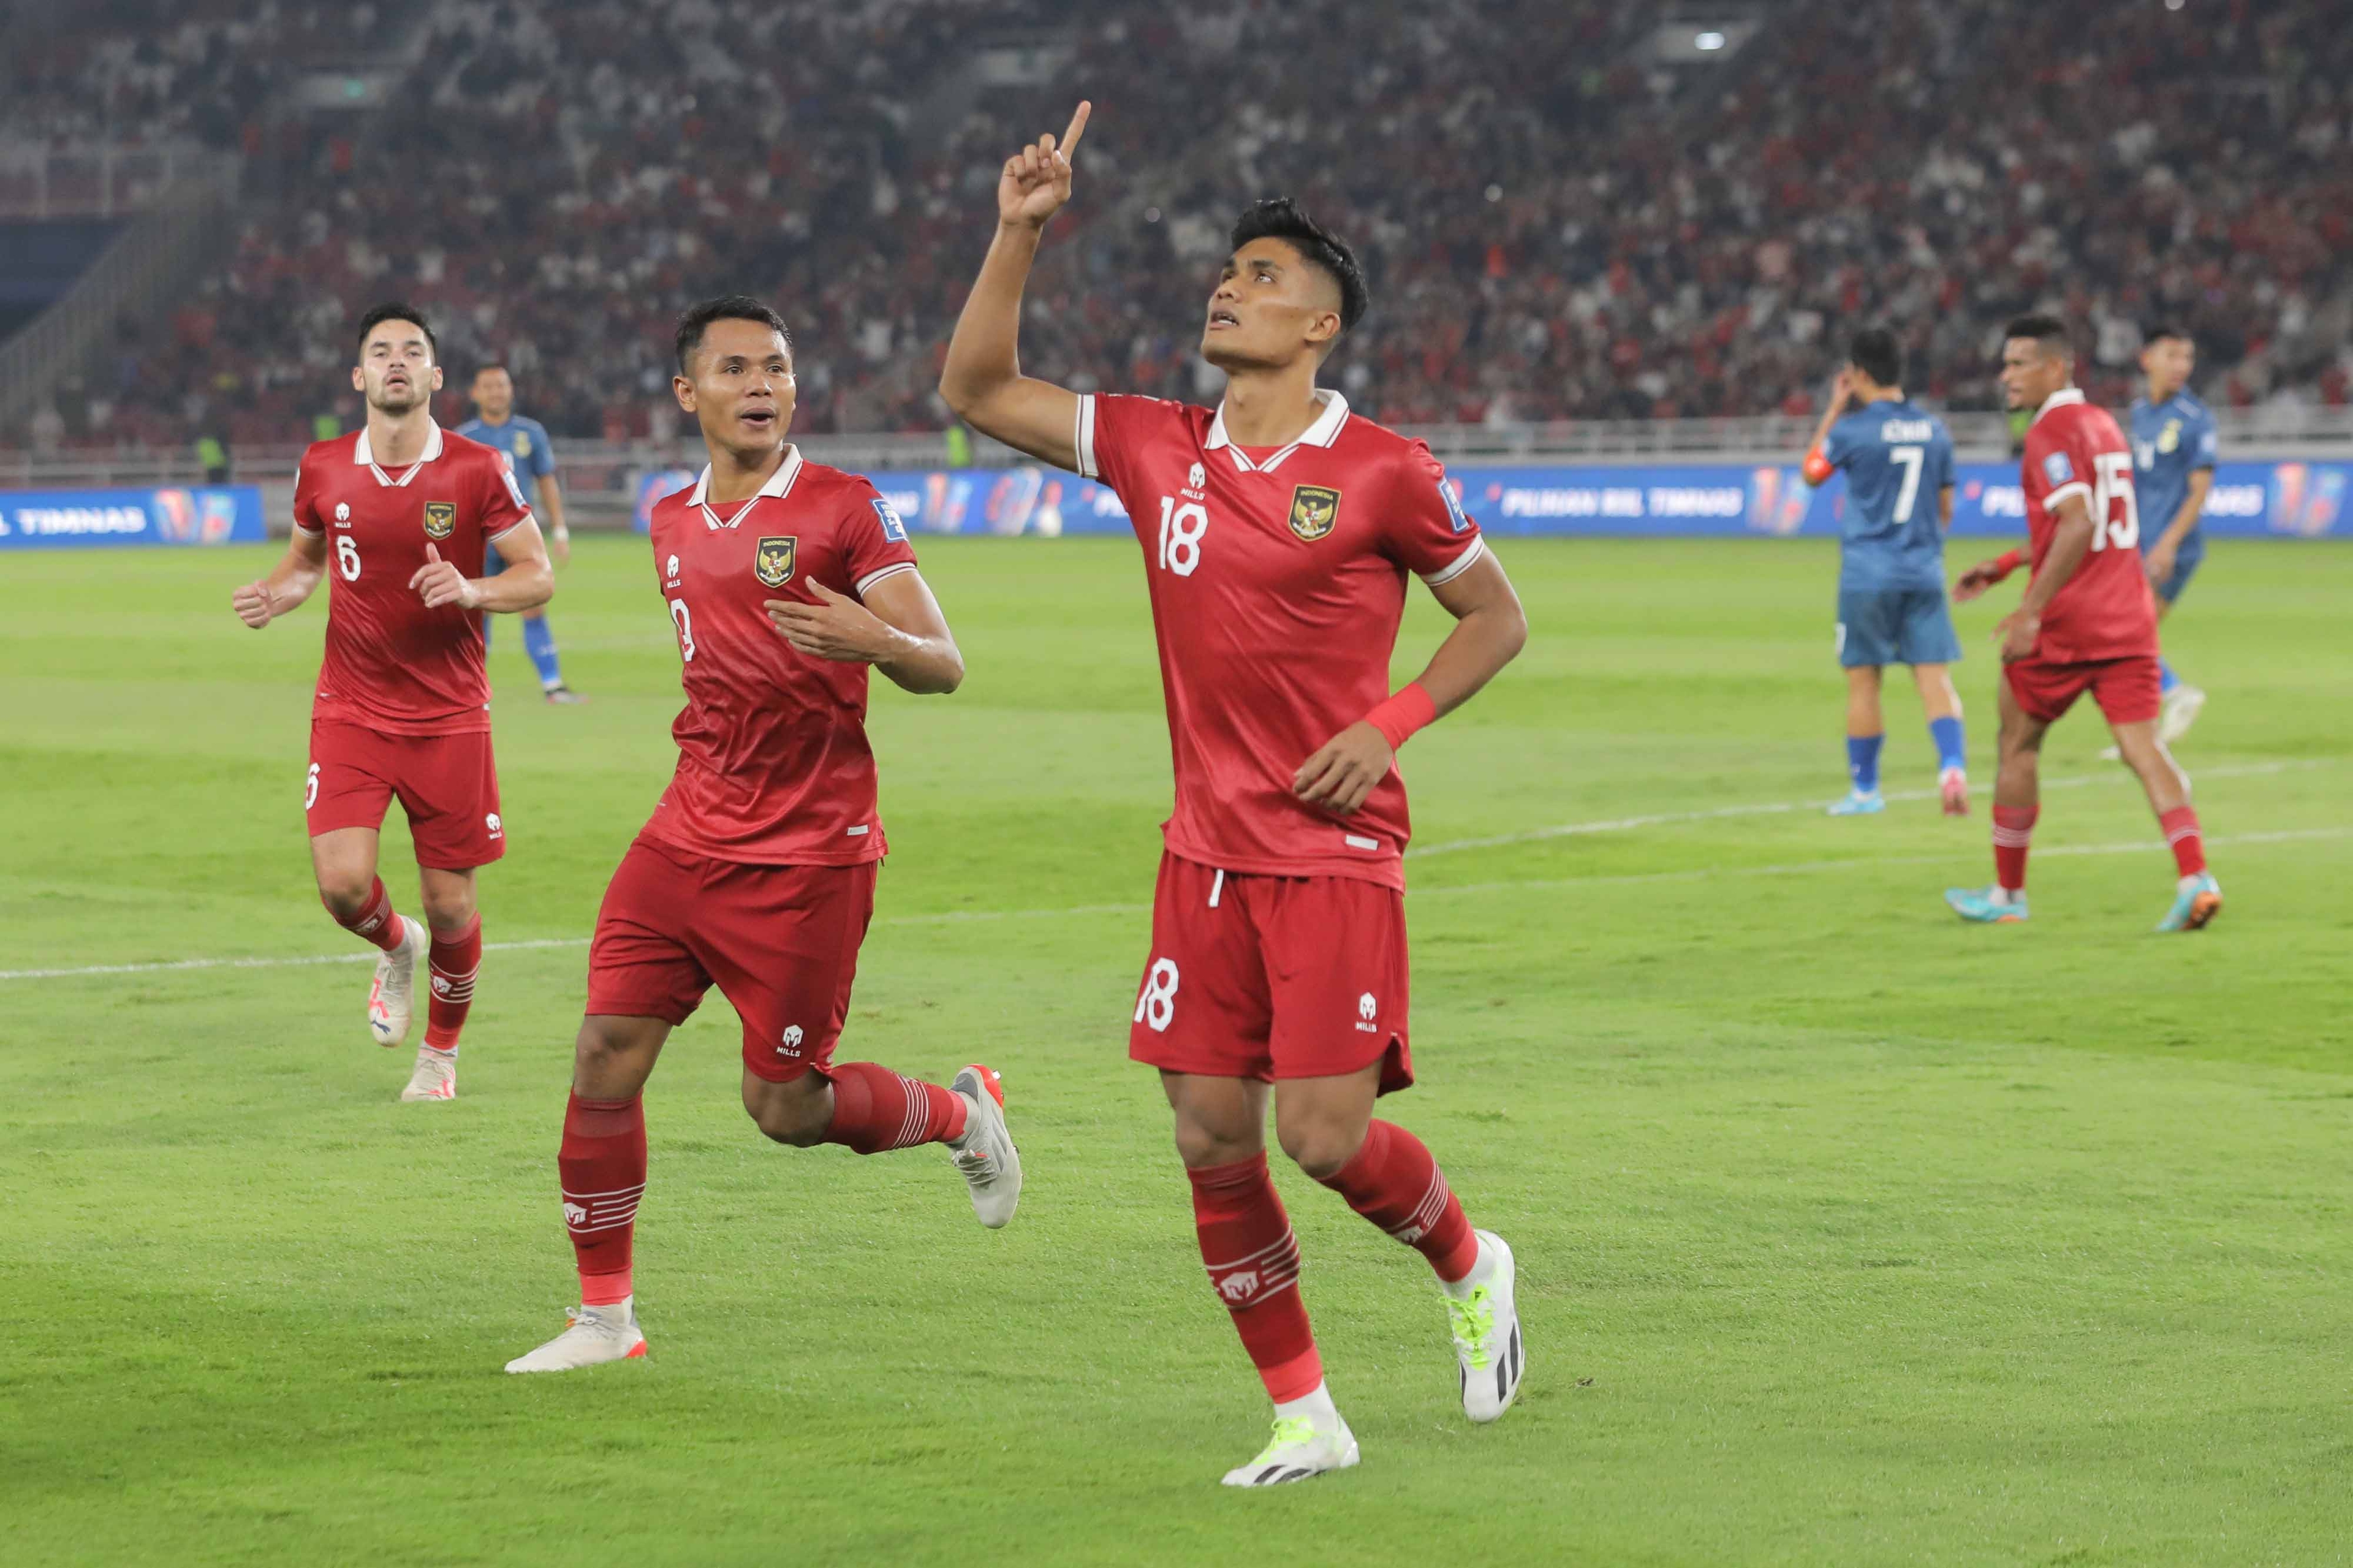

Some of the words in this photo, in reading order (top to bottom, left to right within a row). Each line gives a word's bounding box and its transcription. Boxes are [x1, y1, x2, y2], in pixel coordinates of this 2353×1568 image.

[1180, 488, 1205, 501] MILLS
[1890, 445, 1925, 524] 7
[2091, 452, 2140, 552] 15
[16, 507, 146, 535] TIMNAS
[1158, 495, 1209, 578] 18
[336, 534, 361, 582] 6
[306, 762, 320, 810] 6
[1134, 956, 1180, 1032] 18
[1355, 1021, 1377, 1033] MILLS
[776, 1046, 801, 1058] MILLS
